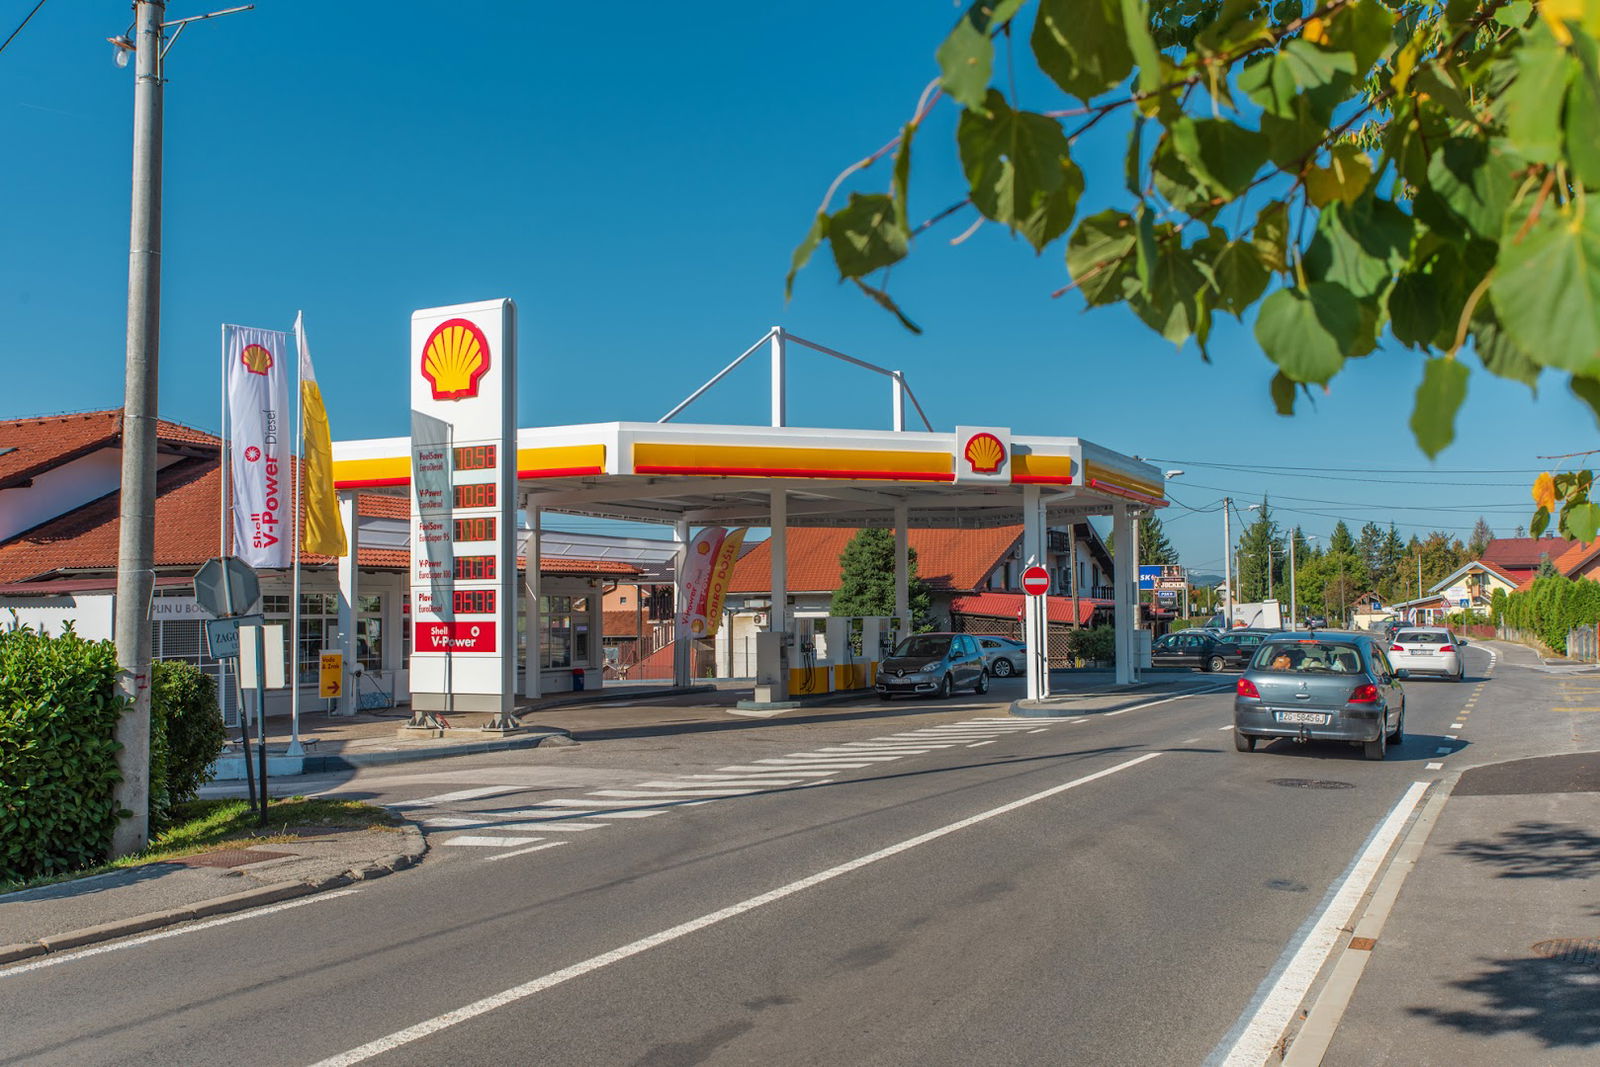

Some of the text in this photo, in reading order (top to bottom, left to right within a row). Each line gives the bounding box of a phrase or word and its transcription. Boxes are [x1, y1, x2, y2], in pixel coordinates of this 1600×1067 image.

[419, 451, 444, 461] FuelSave
[459, 446, 495, 470] 10.58
[419, 462, 444, 472] EuroDiesel
[262, 409, 279, 549] V-Power Diesel
[418, 488, 442, 497] V-Power
[419, 499, 443, 509] EuroDiesel
[251, 513, 262, 549] Shell
[419, 521, 443, 531] FuelSave
[419, 531, 450, 543] EuroSuper 95
[418, 559, 442, 568] V-Power
[418, 570, 442, 580] EuroSuper
[418, 593, 433, 602] Plavi
[175, 604, 183, 613] U
[418, 604, 443, 613] EuroDiesel
[708, 583, 722, 628] DOBRO
[430, 626, 449, 635] Shell
[215, 631, 239, 644] ZAGO
[431, 636, 476, 647] V-Power
